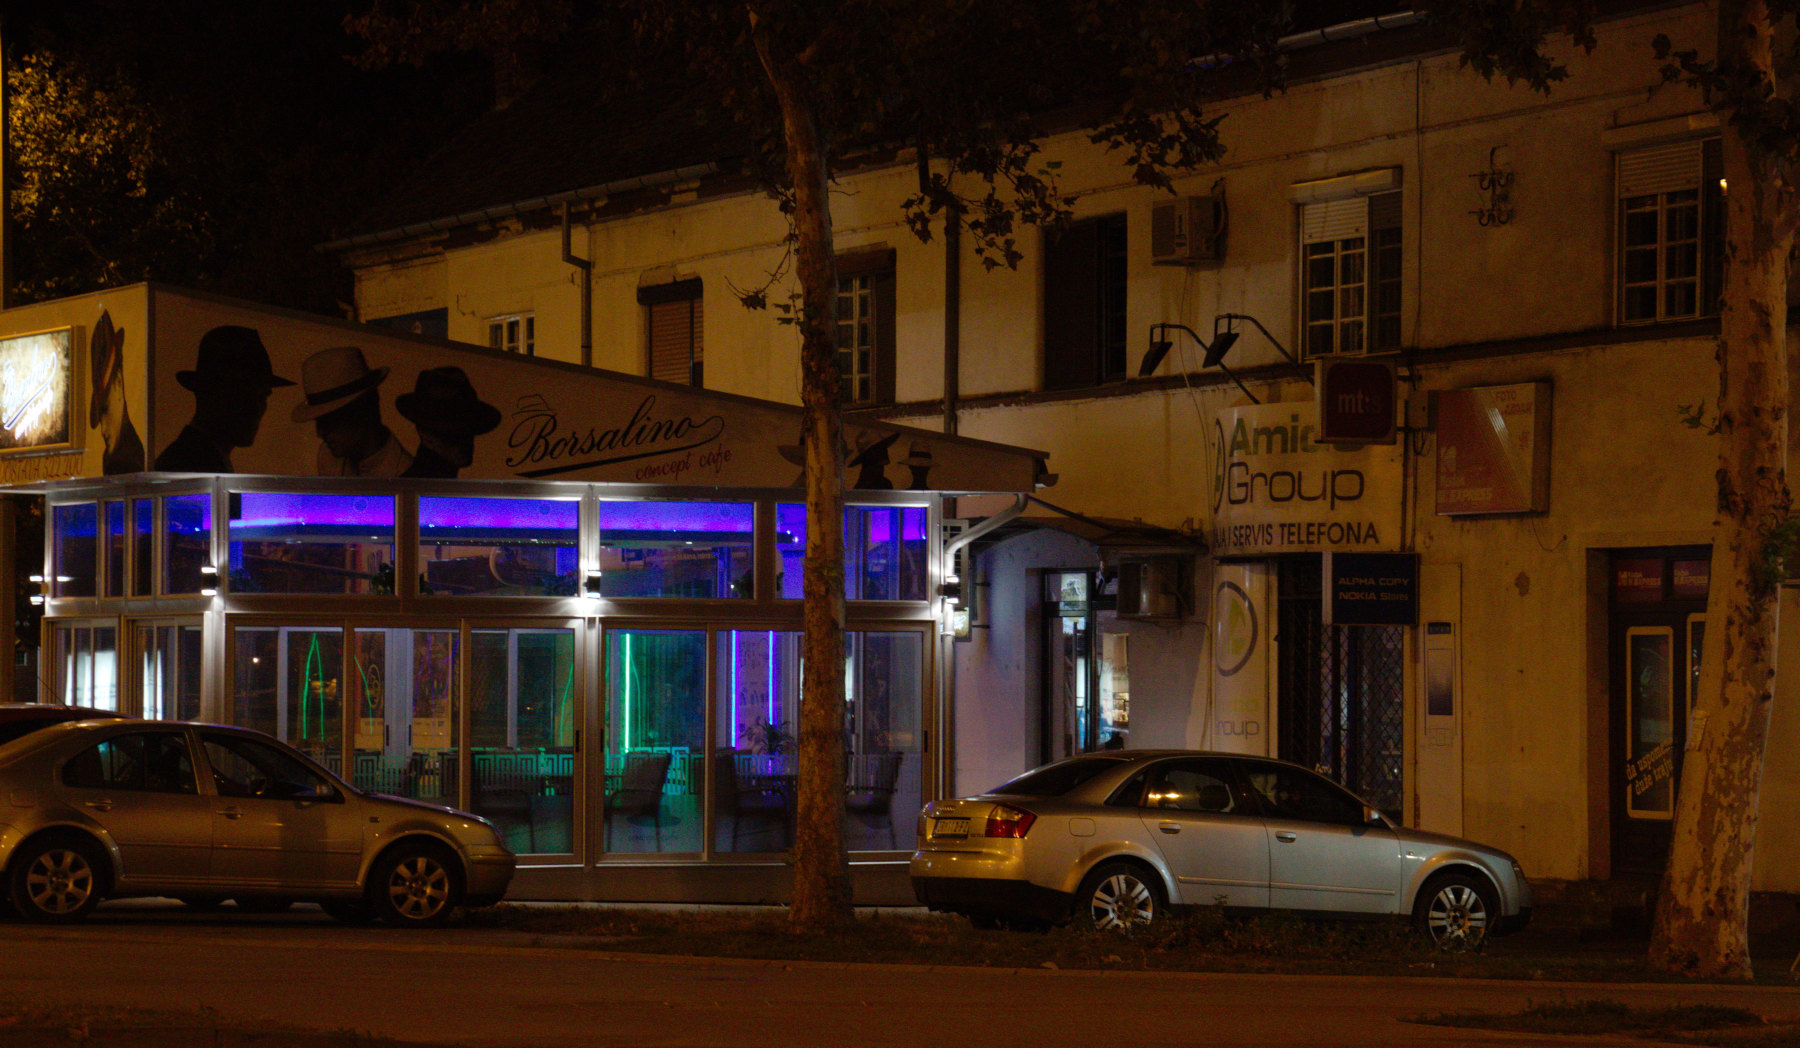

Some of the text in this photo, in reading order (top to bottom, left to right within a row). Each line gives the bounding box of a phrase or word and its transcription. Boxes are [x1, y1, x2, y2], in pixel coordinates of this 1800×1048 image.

[505, 394, 725, 467] Borsalino
[1229, 413, 1364, 458] Amic
[635, 443, 733, 481] concept cafe
[1227, 461, 1365, 511] Group
[1233, 523, 1274, 547] SERVIS
[1279, 521, 1380, 545] TELEFONA
[1338, 577, 1409, 586] ALPHA COPY
[1338, 591, 1377, 600] NOKIA
